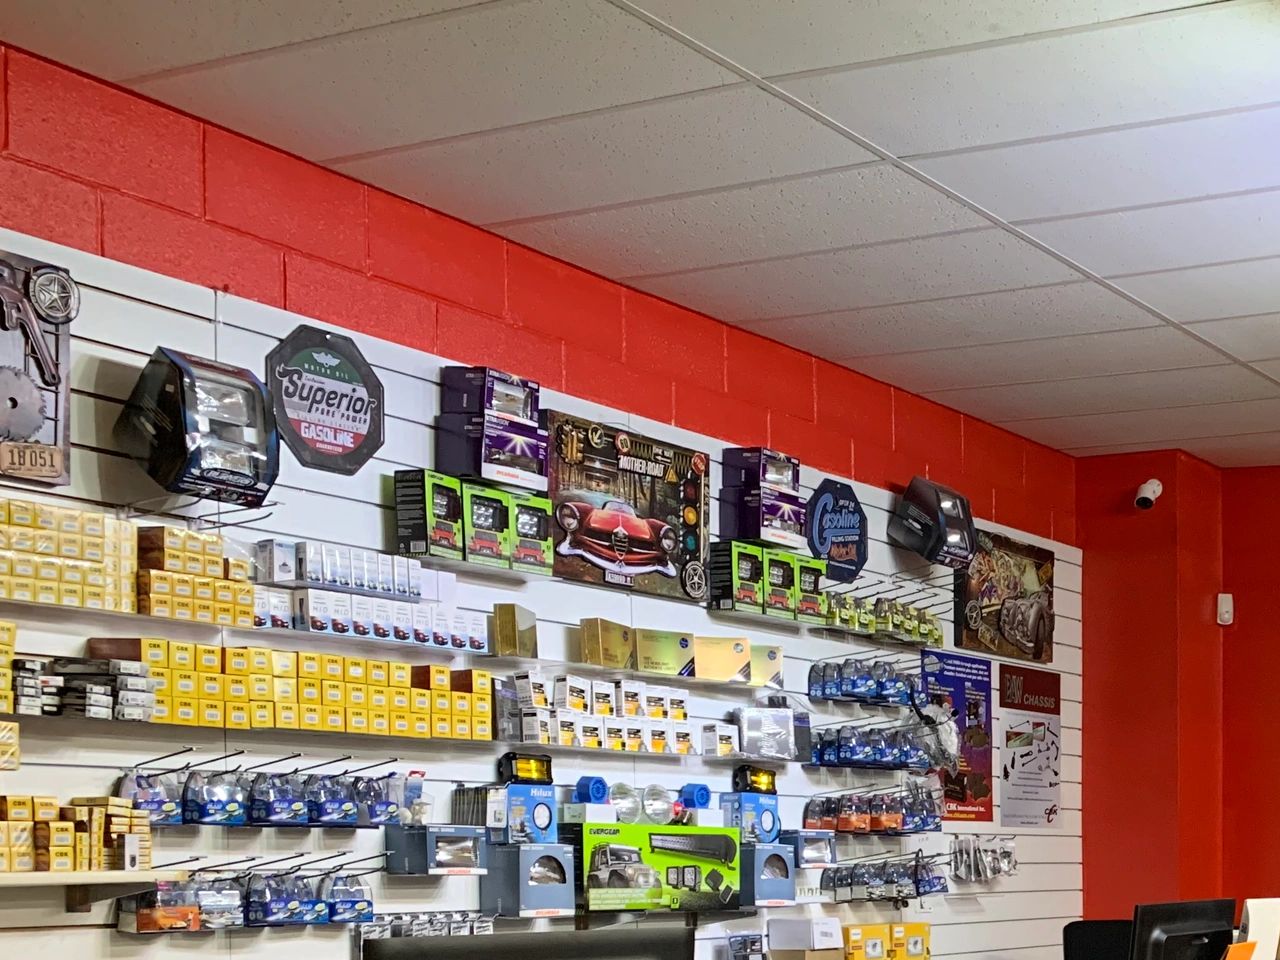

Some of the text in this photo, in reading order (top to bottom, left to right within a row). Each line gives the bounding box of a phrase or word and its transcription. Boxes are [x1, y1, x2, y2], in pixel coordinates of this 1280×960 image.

[276, 363, 377, 416] Superior
[315, 407, 336, 418] PURE
[341, 413, 367, 425] POWER
[813, 492, 860, 554] Gasoline
[1024, 693, 1055, 709] CHASSIS
[530, 787, 552, 797] Hilux
